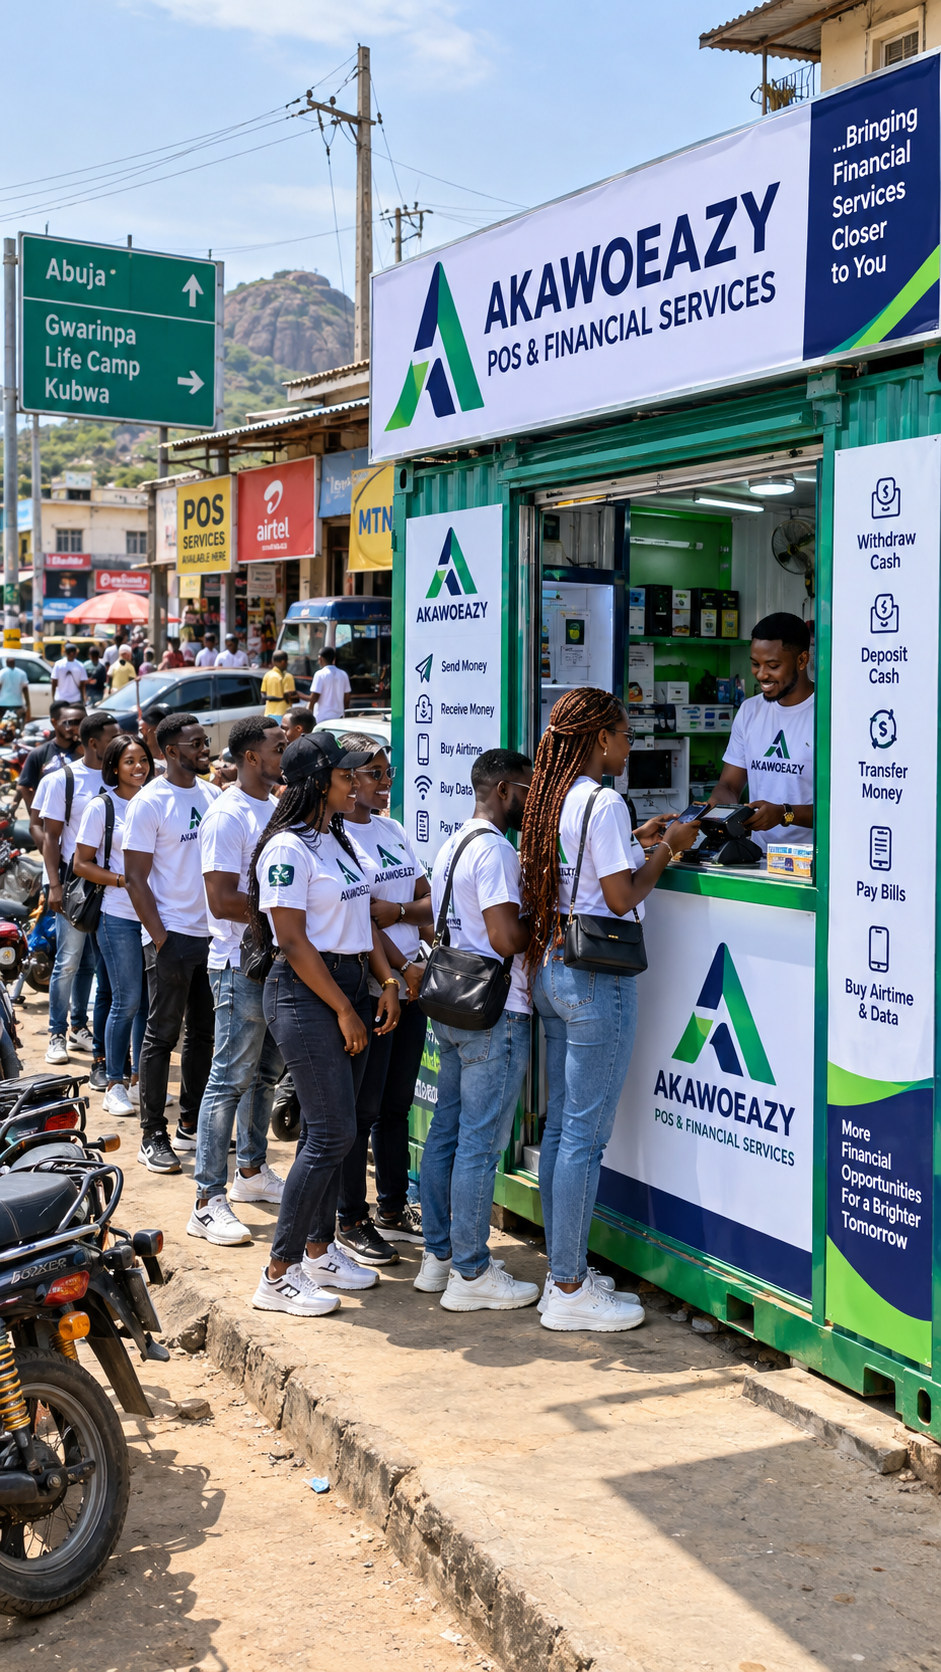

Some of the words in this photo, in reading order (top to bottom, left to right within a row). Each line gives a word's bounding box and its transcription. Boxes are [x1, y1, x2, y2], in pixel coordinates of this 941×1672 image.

[833, 107, 918, 154] ...Bringing
[833, 140, 911, 186] Financial
[832, 181, 905, 219] Services
[832, 221, 887, 251] Closer
[484, 181, 781, 335] AKAWOEAZY
[831, 262, 848, 284] to
[853, 254, 887, 281] You
[46, 258, 106, 287] Abuja
[45, 314, 137, 348] Gwarinpa
[488, 342, 522, 377] POS
[526, 339, 540, 366] &
[544, 306, 653, 360] FINANCIAL
[659, 270, 776, 331] SERVICES
[45, 346, 82, 370] Life
[87, 350, 140, 381] Camp
[45, 377, 110, 404] Kubwa
[183, 493, 225, 530] POS
[358, 505, 393, 536] MTN
[183, 531, 225, 549] SERVICES
[256, 516, 290, 542] airtel
[857, 531, 916, 550] Withdraw
[870, 552, 901, 570] Cash
[416, 601, 488, 623] AKAWOEAZY
[441, 659, 460, 673] Send
[462, 659, 488, 674] Money
[861, 646, 908, 666] Deposit
[869, 667, 899, 684] Cash
[440, 703, 468, 716] Receive
[470, 703, 495, 718] Money
[440, 742, 455, 757] Buy
[456, 742, 482, 756] Airtime
[751, 759, 805, 775] AKAWOEAZY
[858, 761, 908, 779] Transfer
[440, 782, 455, 797] Buy
[456, 782, 473, 796] Data
[861, 783, 903, 805] Money
[440, 820, 454, 837] Pay
[856, 881, 878, 901] Pay
[881, 883, 906, 902] Bills
[845, 978, 868, 1000] Buy
[870, 983, 914, 1007] Airtime
[858, 1004, 868, 1020] &
[871, 1005, 899, 1026] Data
[653, 1069, 796, 1137] AKAWOEAZY
[654, 1107, 674, 1127] POS
[676, 1116, 683, 1130] &
[685, 1118, 740, 1149] FINANCIAL
[743, 1136, 795, 1167] SERVICES
[842, 1119, 871, 1142] More
[842, 1141, 892, 1171] Financial
[841, 1164, 922, 1204] Opportunities
[842, 1187, 860, 1208] For
[863, 1200, 870, 1212] a
[873, 1197, 921, 1228] Brighter
[841, 1210, 908, 1250] Tomorrow
